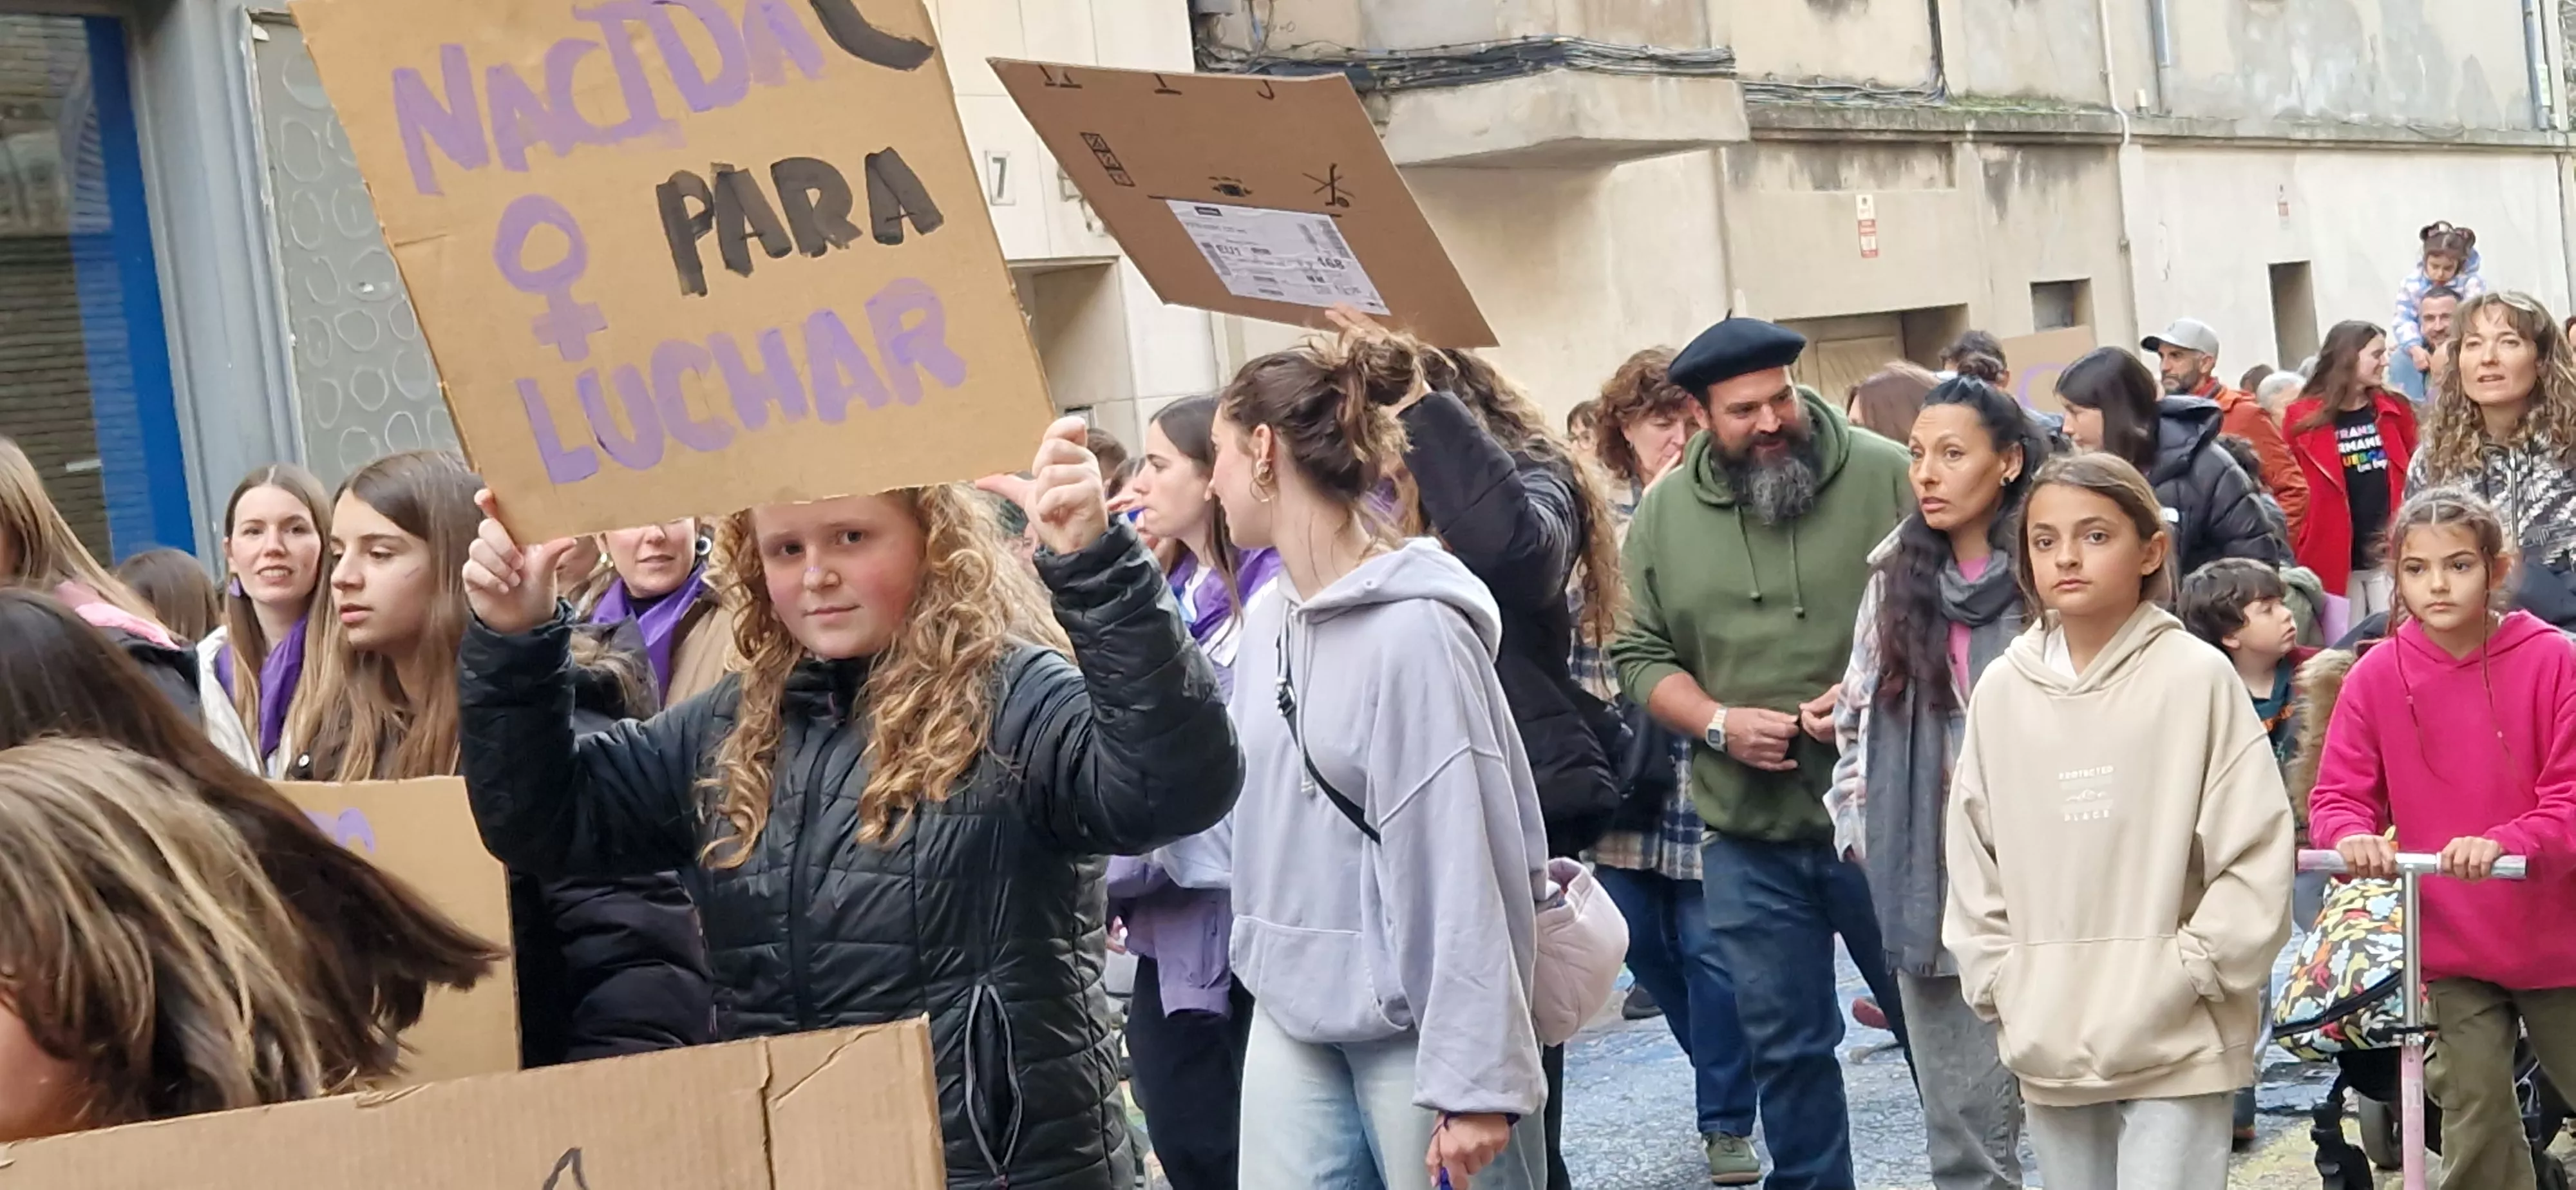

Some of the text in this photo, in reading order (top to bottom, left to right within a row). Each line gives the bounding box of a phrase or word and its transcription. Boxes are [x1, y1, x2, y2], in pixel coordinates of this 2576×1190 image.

[391, 0, 826, 196] NACIDA
[992, 156, 1007, 198] 7
[656, 147, 943, 296] PARA
[516, 278, 966, 485] LUCHAR
